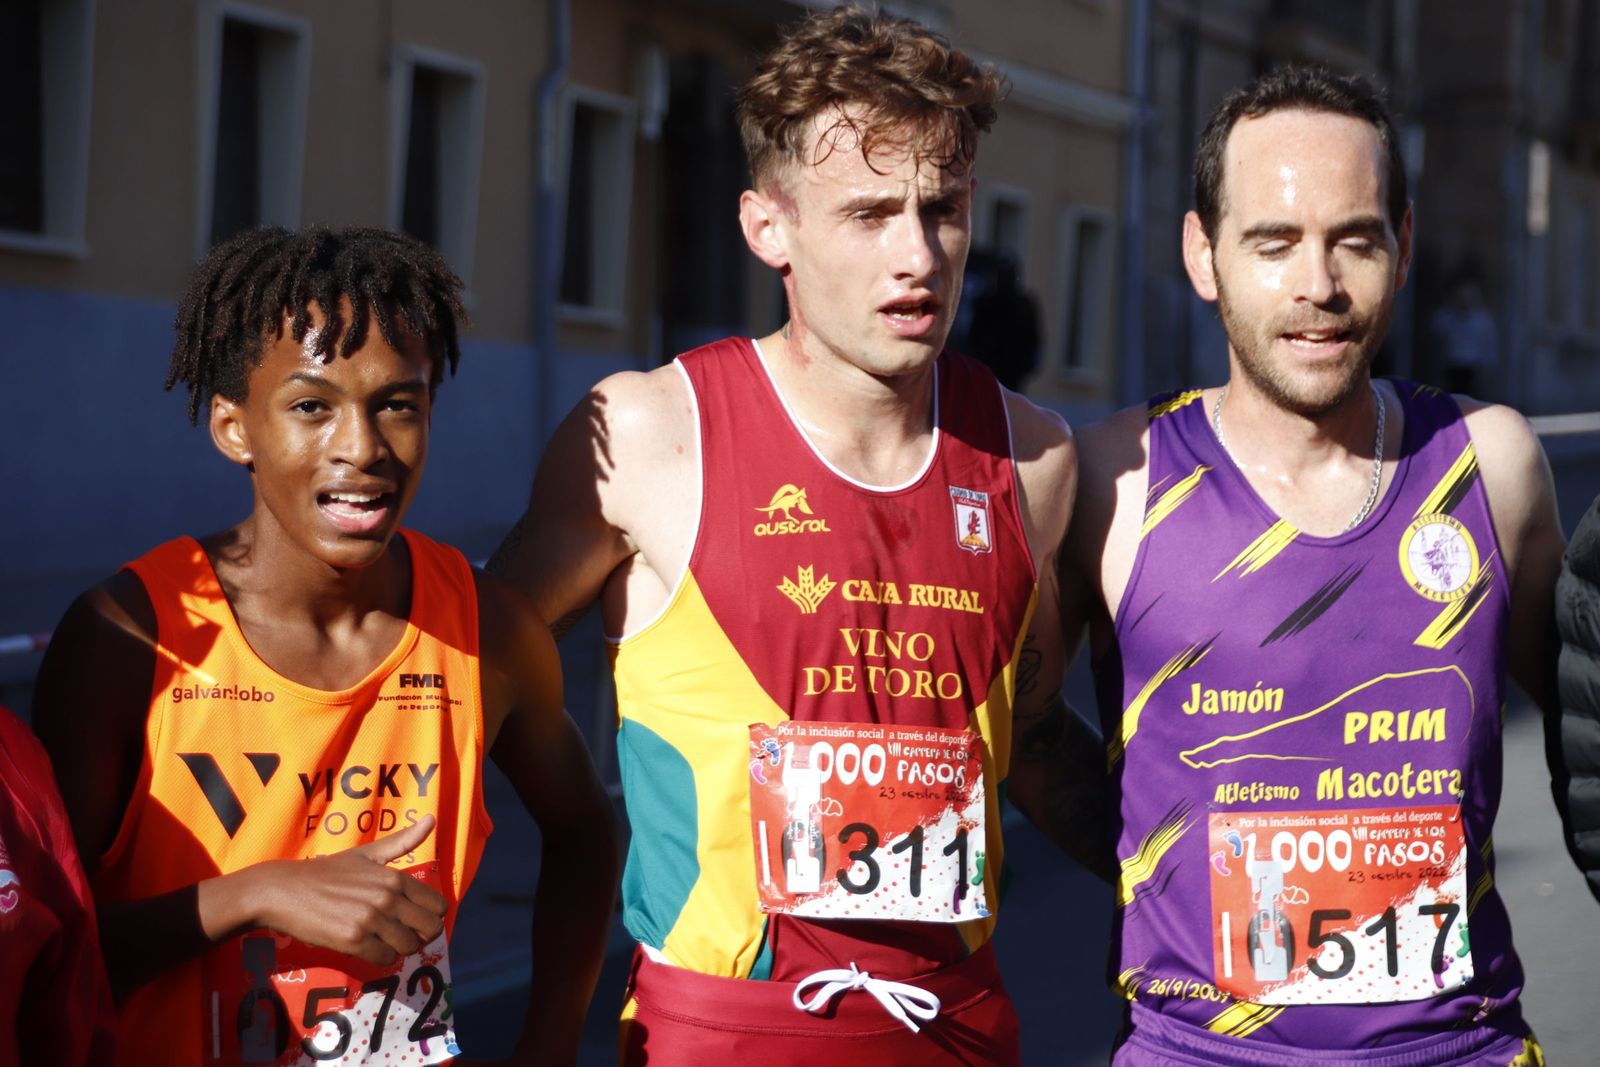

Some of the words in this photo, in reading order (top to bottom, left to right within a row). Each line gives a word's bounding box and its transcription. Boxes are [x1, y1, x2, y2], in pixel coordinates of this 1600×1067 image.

[754, 519, 831, 536] austral
[841, 579, 903, 605] CAJA
[908, 583, 984, 614] RURAL
[840, 628, 935, 661] VINO
[399, 674, 446, 688] FMD
[803, 665, 857, 696] DE
[864, 666, 963, 699] TORO
[1182, 681, 1284, 715] Jamón
[778, 726, 794, 736] Por
[797, 726, 806, 736] la
[809, 727, 855, 738] inclusión
[857, 728, 884, 739] social
[897, 731, 923, 741] través
[925, 731, 938, 742] del
[939, 733, 968, 746] deporte
[1343, 708, 1446, 745] PRIM
[298, 763, 440, 805] VICKY
[897, 759, 966, 788] PASOS
[1214, 782, 1300, 803] Atletismo
[1316, 762, 1462, 800] Macotera
[880, 787, 896, 800] 23
[304, 809, 418, 838] FOODS
[1240, 817, 1256, 827] Por
[1258, 816, 1267, 827] la
[1270, 815, 1316, 826] inclusión
[1318, 814, 1348, 825] social
[1353, 816, 1360, 824] a
[1362, 813, 1391, 824] través
[1393, 811, 1407, 823] del
[1409, 811, 1442, 824] deporte
[1364, 840, 1445, 867] PASOS
[1349, 870, 1366, 883] 23
[1418, 867, 1447, 879] 2022
